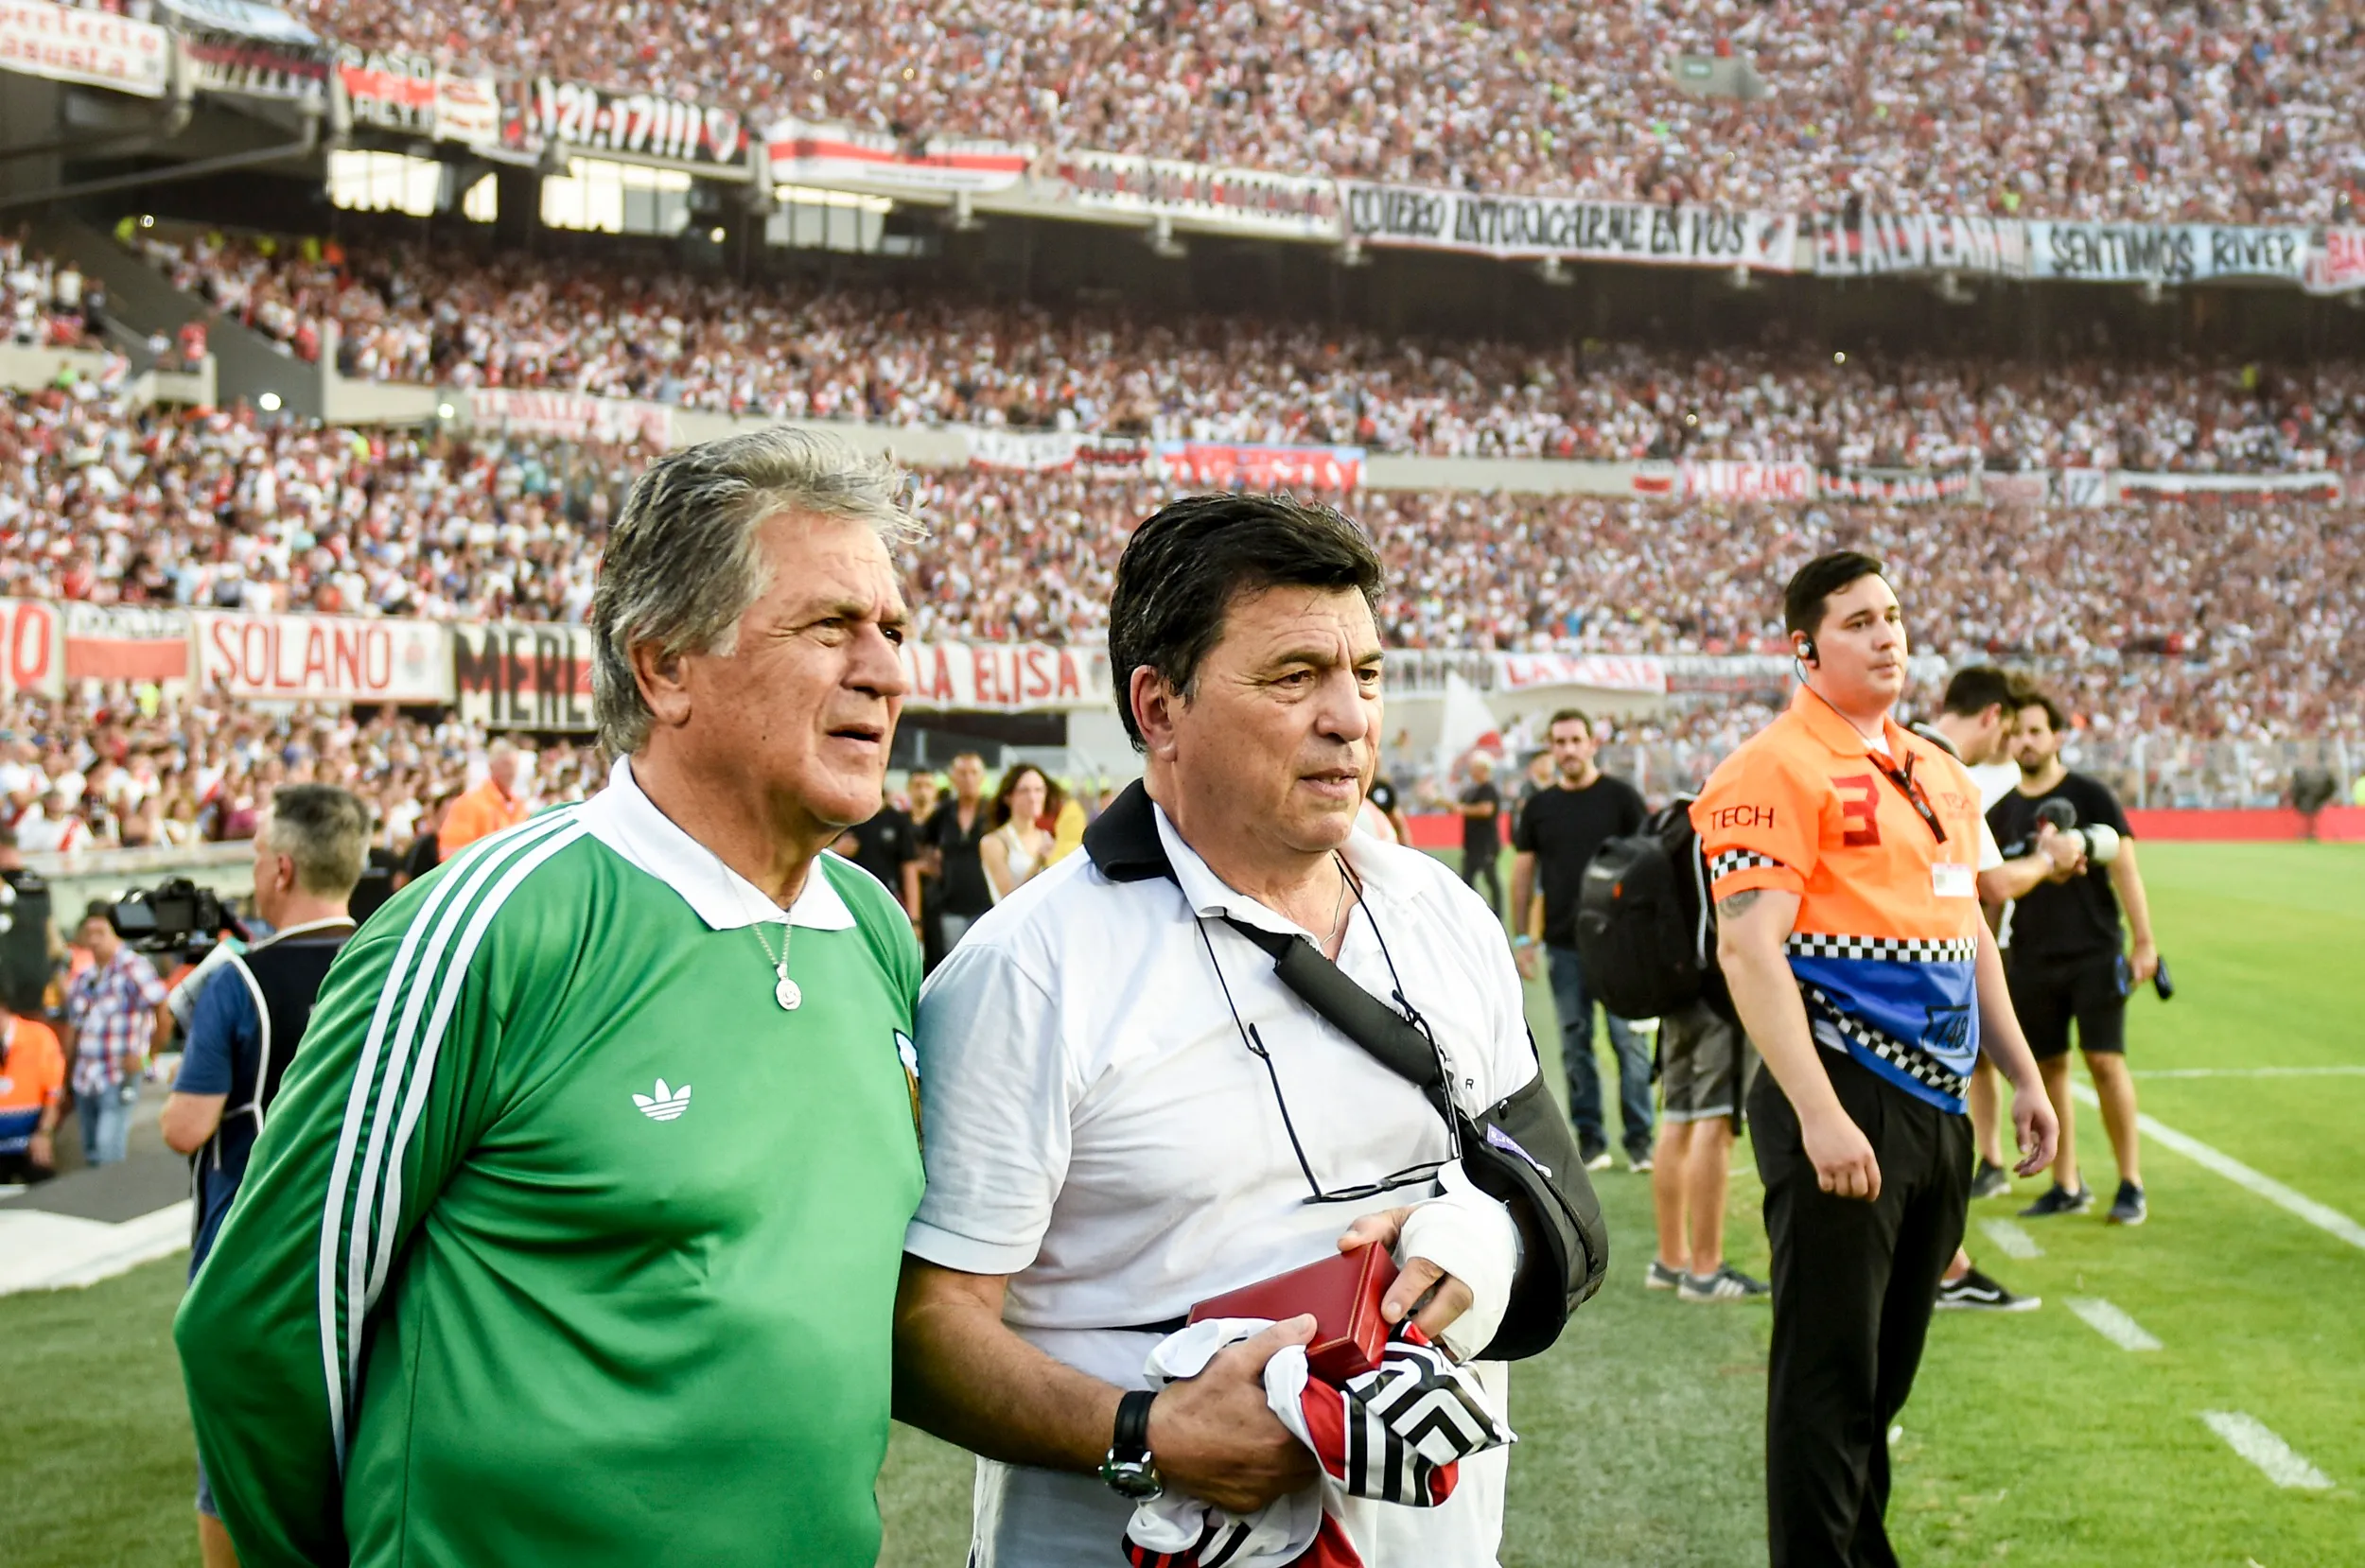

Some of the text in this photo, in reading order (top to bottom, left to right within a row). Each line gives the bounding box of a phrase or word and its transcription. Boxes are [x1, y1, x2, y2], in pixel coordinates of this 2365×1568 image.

[2051, 221, 2196, 278] SENTIMOS
[2212, 229, 2293, 272] RIVER
[211, 619, 391, 689] SOLANO
[972, 645, 1080, 704] ELISA
[1709, 805, 1775, 830] TECH
